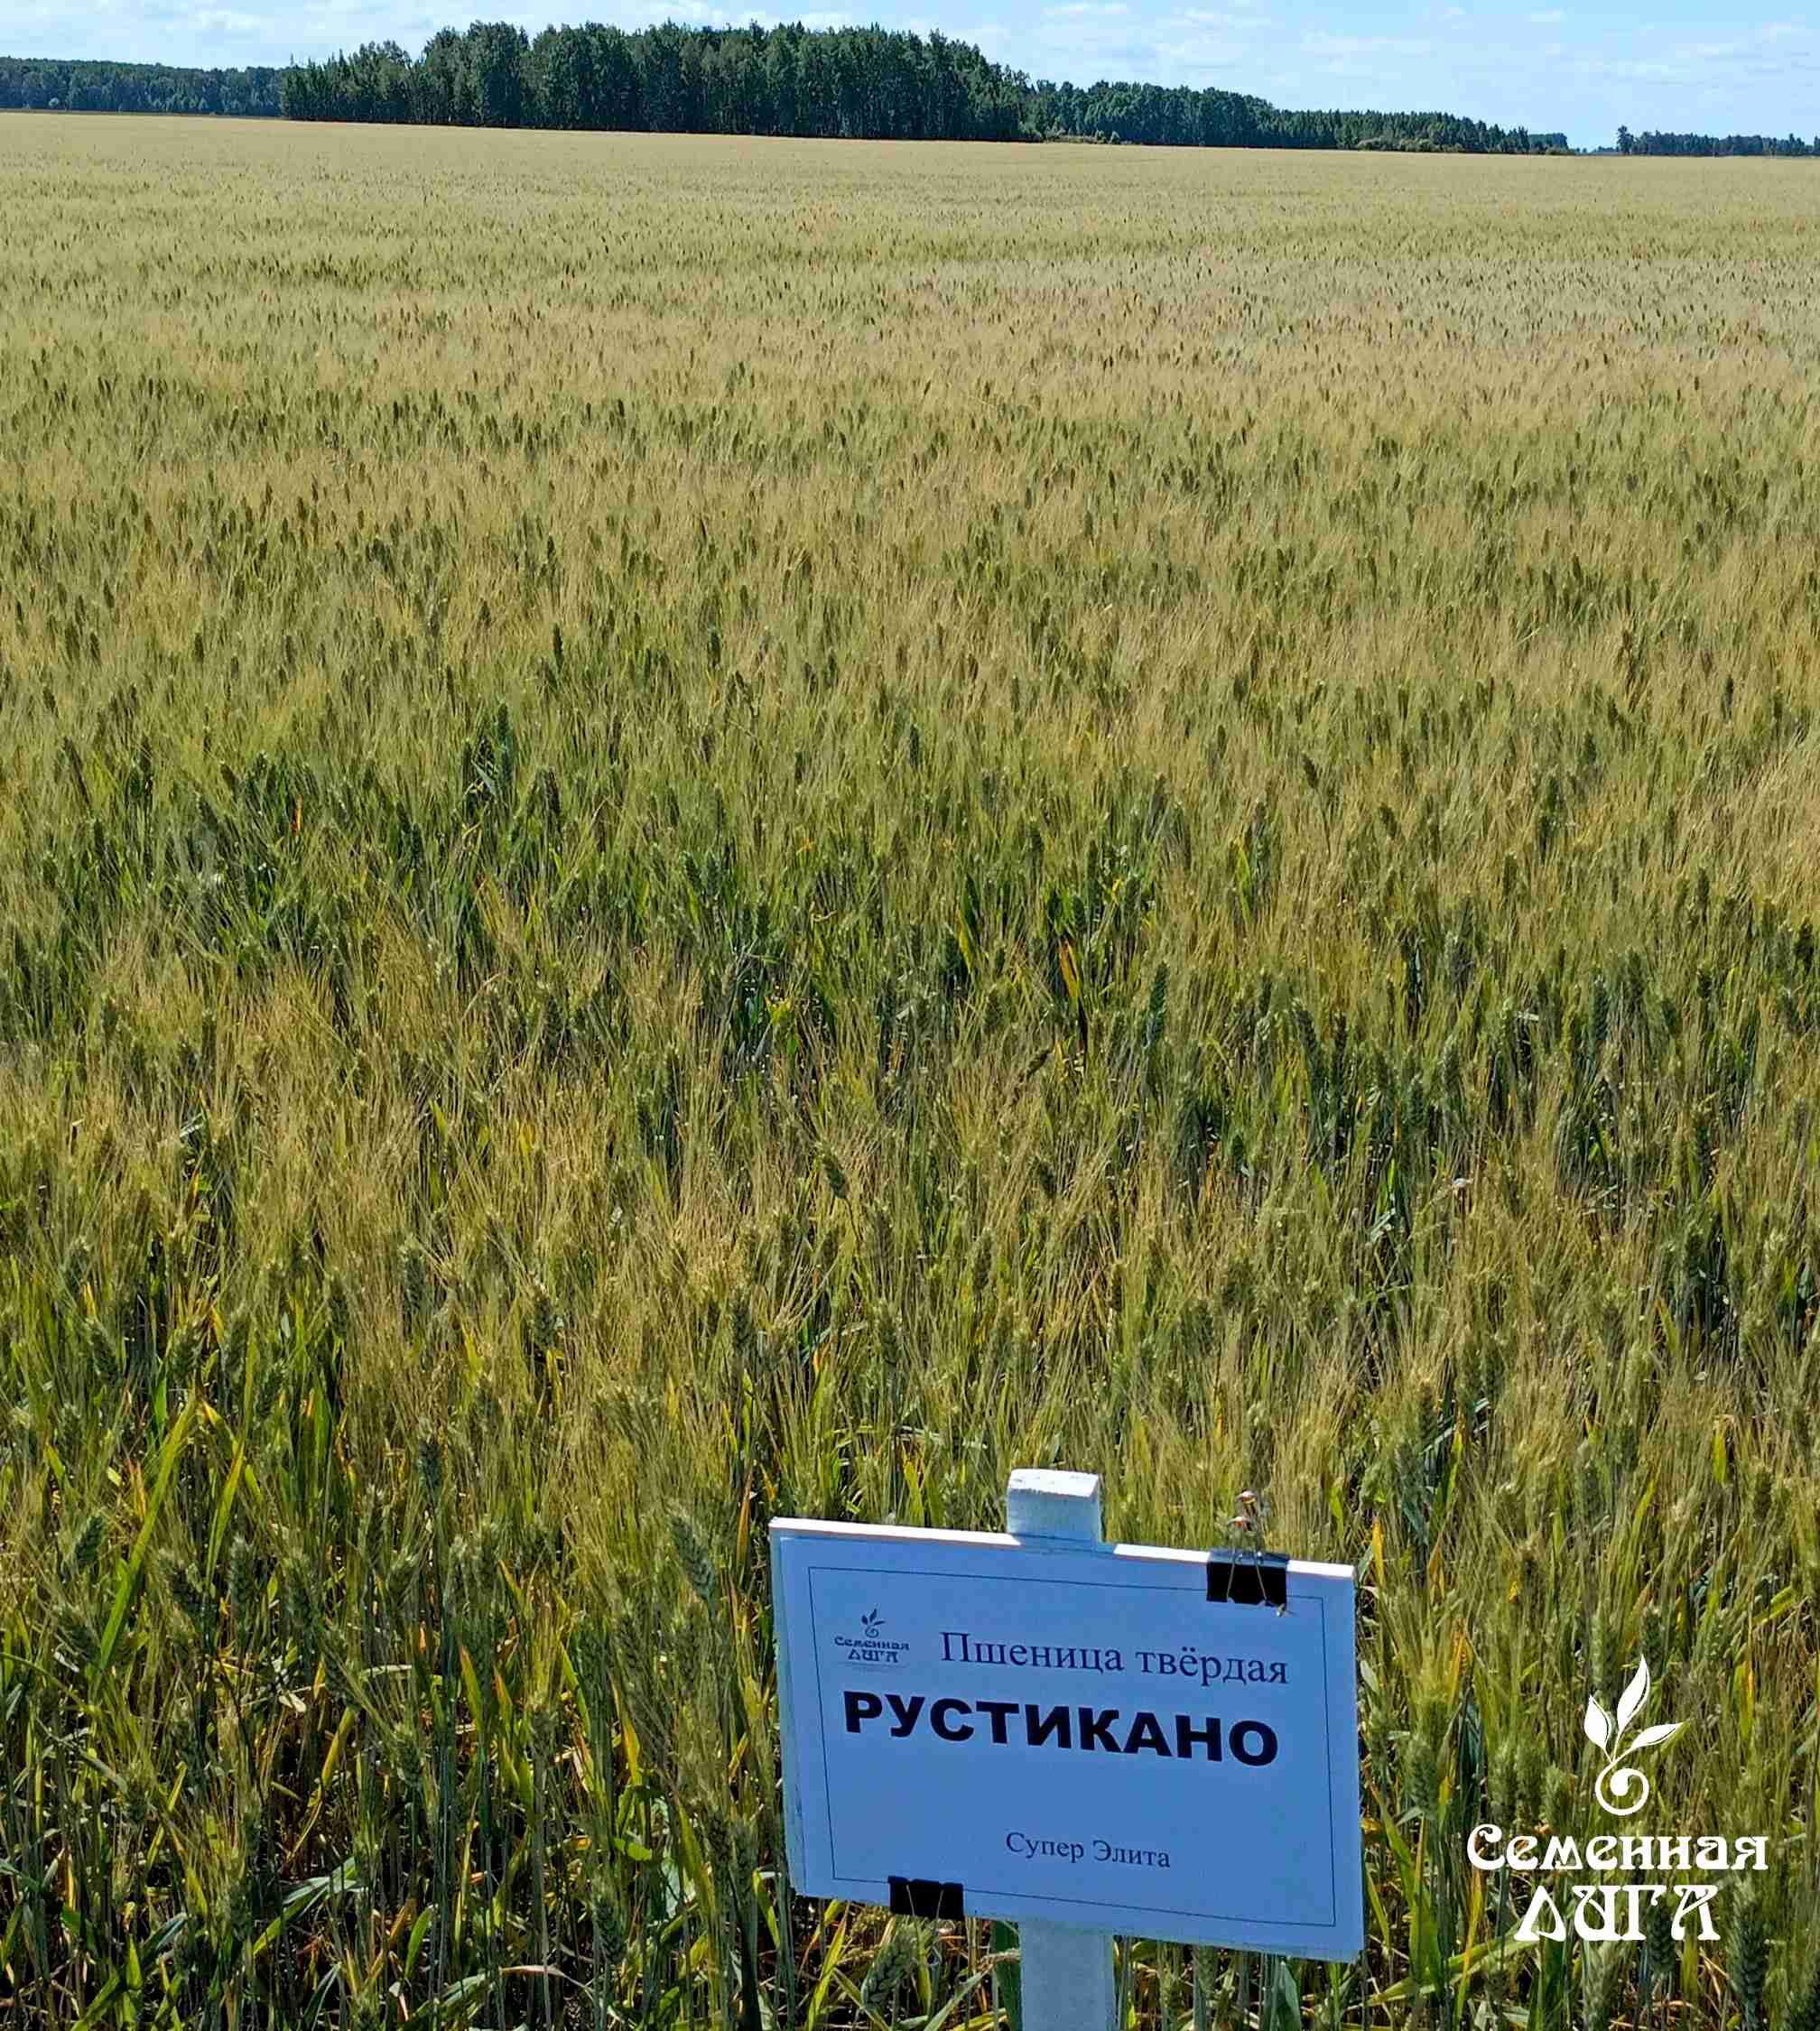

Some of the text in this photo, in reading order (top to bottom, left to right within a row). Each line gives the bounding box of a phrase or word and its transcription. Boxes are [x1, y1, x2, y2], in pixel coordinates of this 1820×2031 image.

[834, 1636, 910, 1651] Семенная
[940, 1631, 1288, 1686] Пшеница твёрдая
[843, 1690, 1279, 1767] РУСТИКАНО
[1005, 1832, 1171, 1869] Супер Элита
